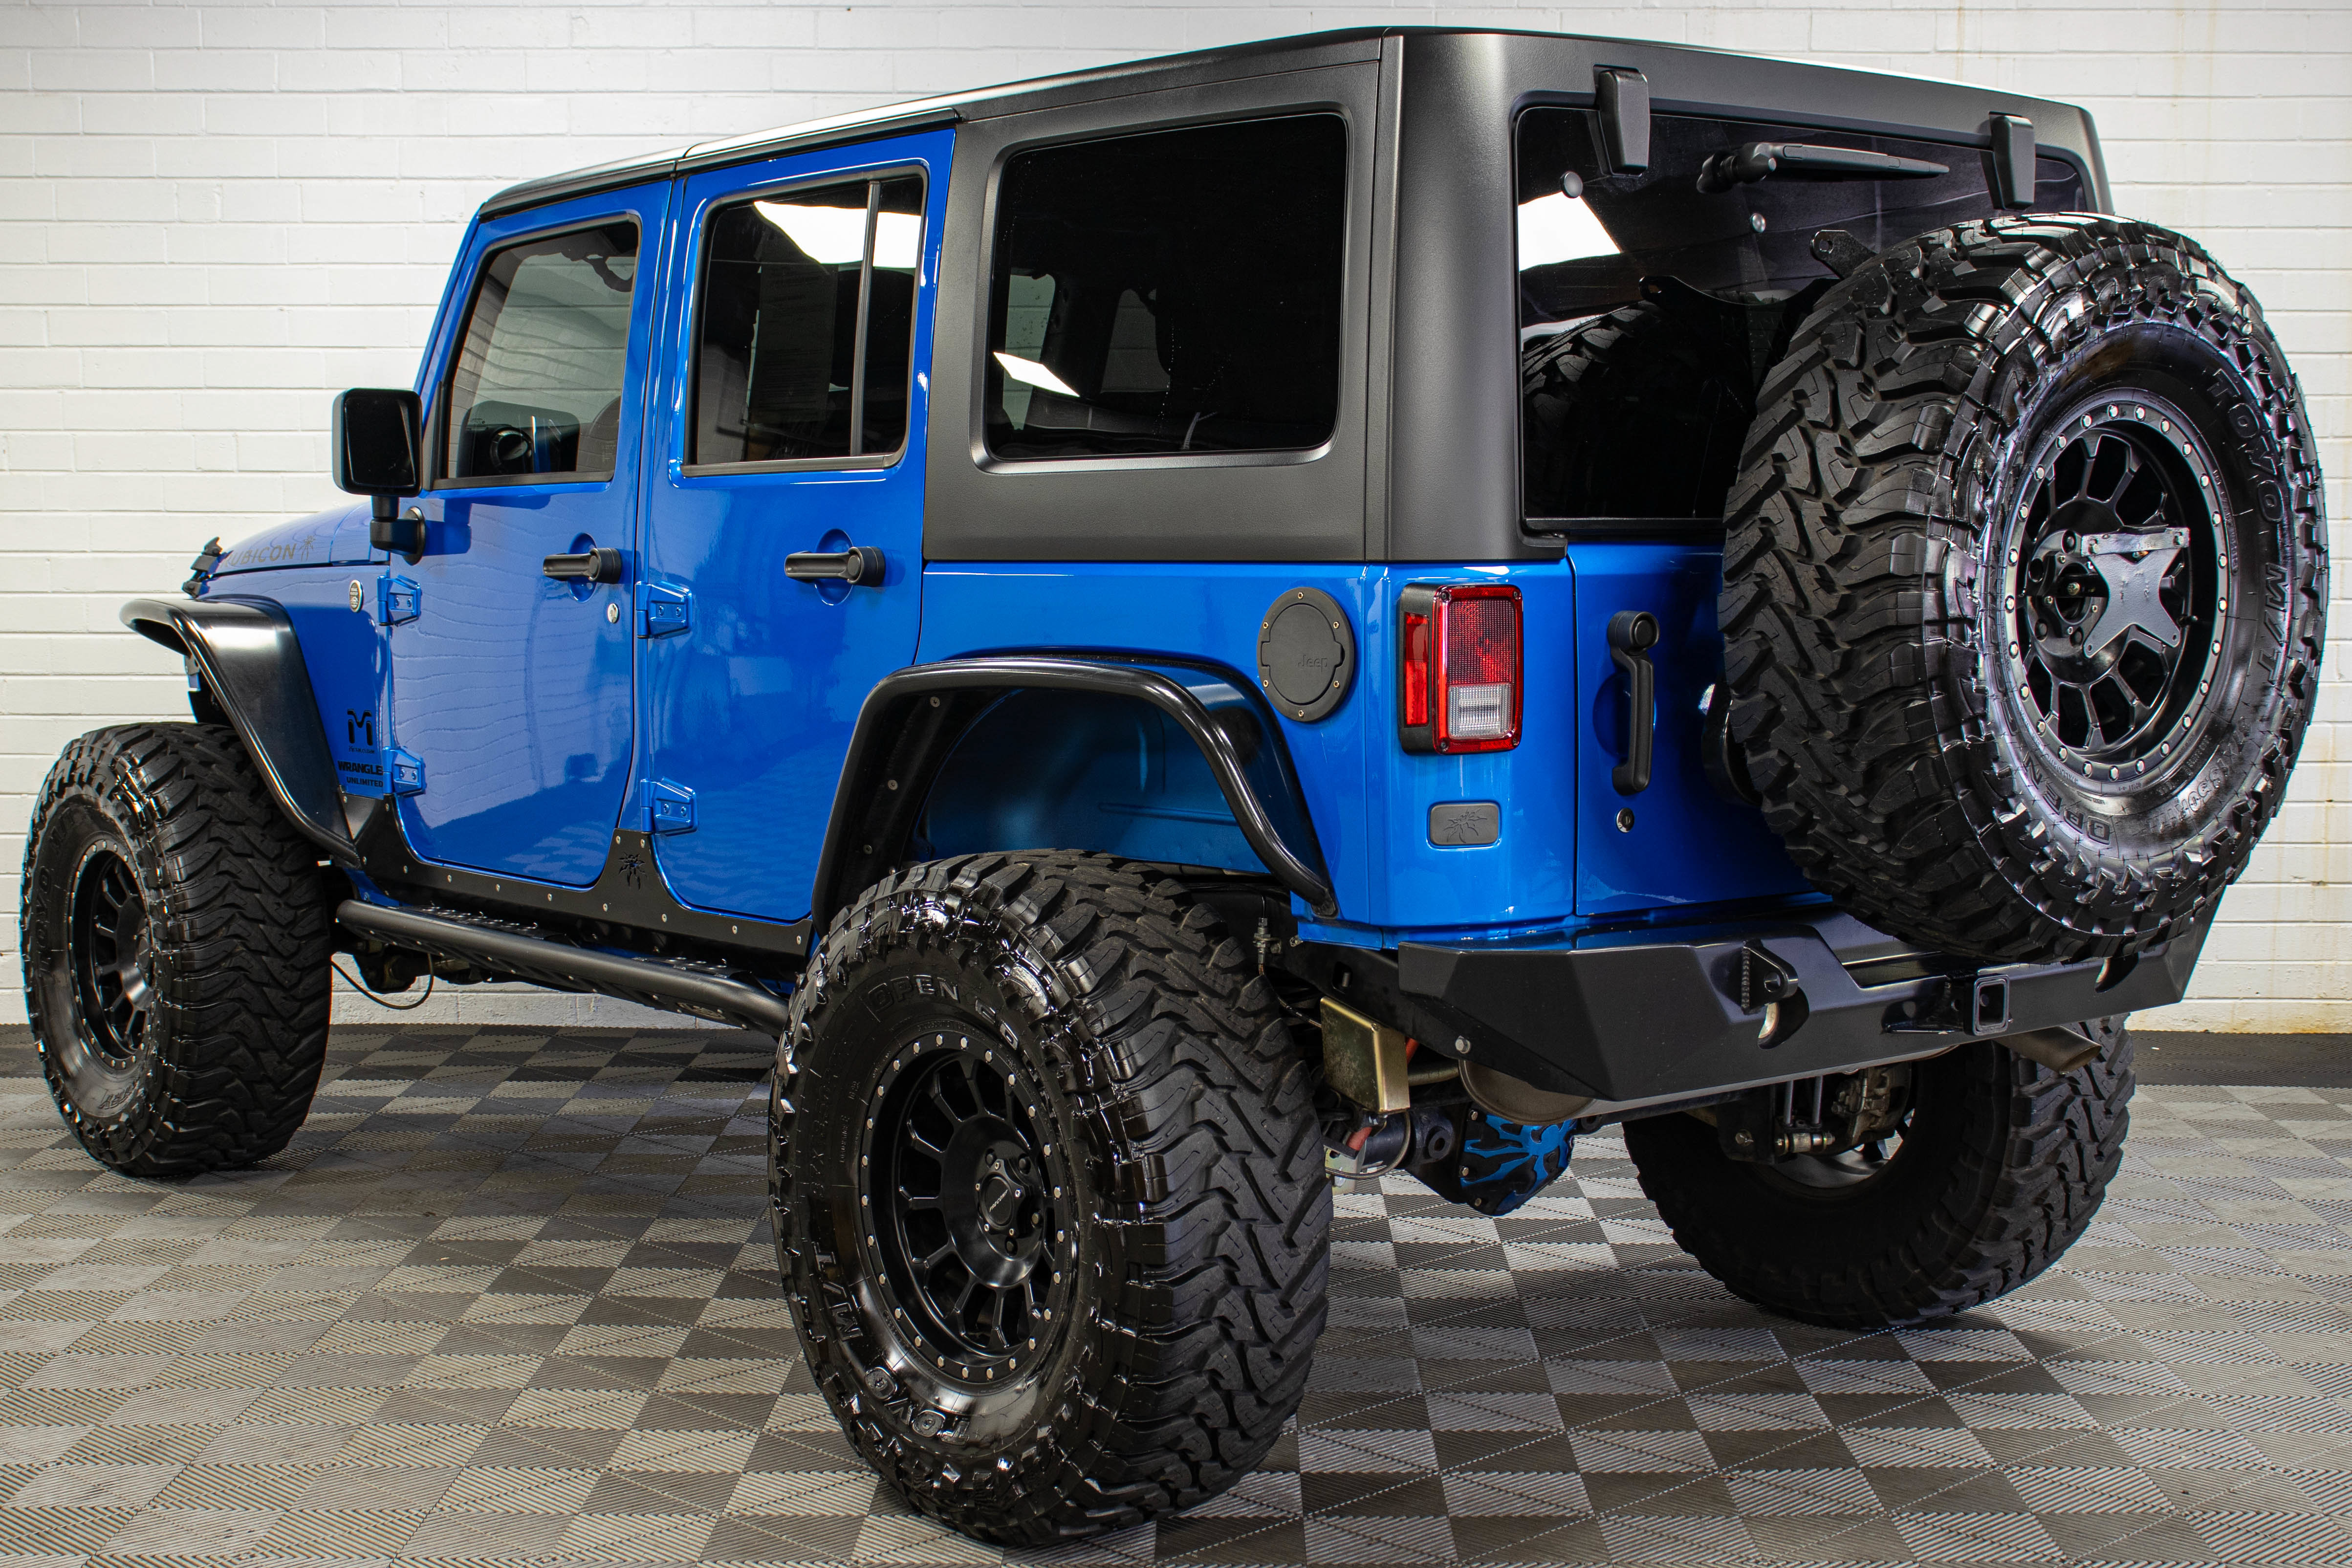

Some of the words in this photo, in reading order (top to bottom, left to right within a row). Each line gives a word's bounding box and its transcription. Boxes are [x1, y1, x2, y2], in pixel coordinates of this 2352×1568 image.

[2206, 368, 2284, 522] TOYO
[2258, 562, 2288, 685] M/T
[1298, 654, 1328, 672] Jeep
[347, 777, 383, 787] UNLIMITED
[2022, 751, 2111, 845] OPEN
[868, 975, 961, 1012] OPEN
[864, 1366, 972, 1446] TOYO
